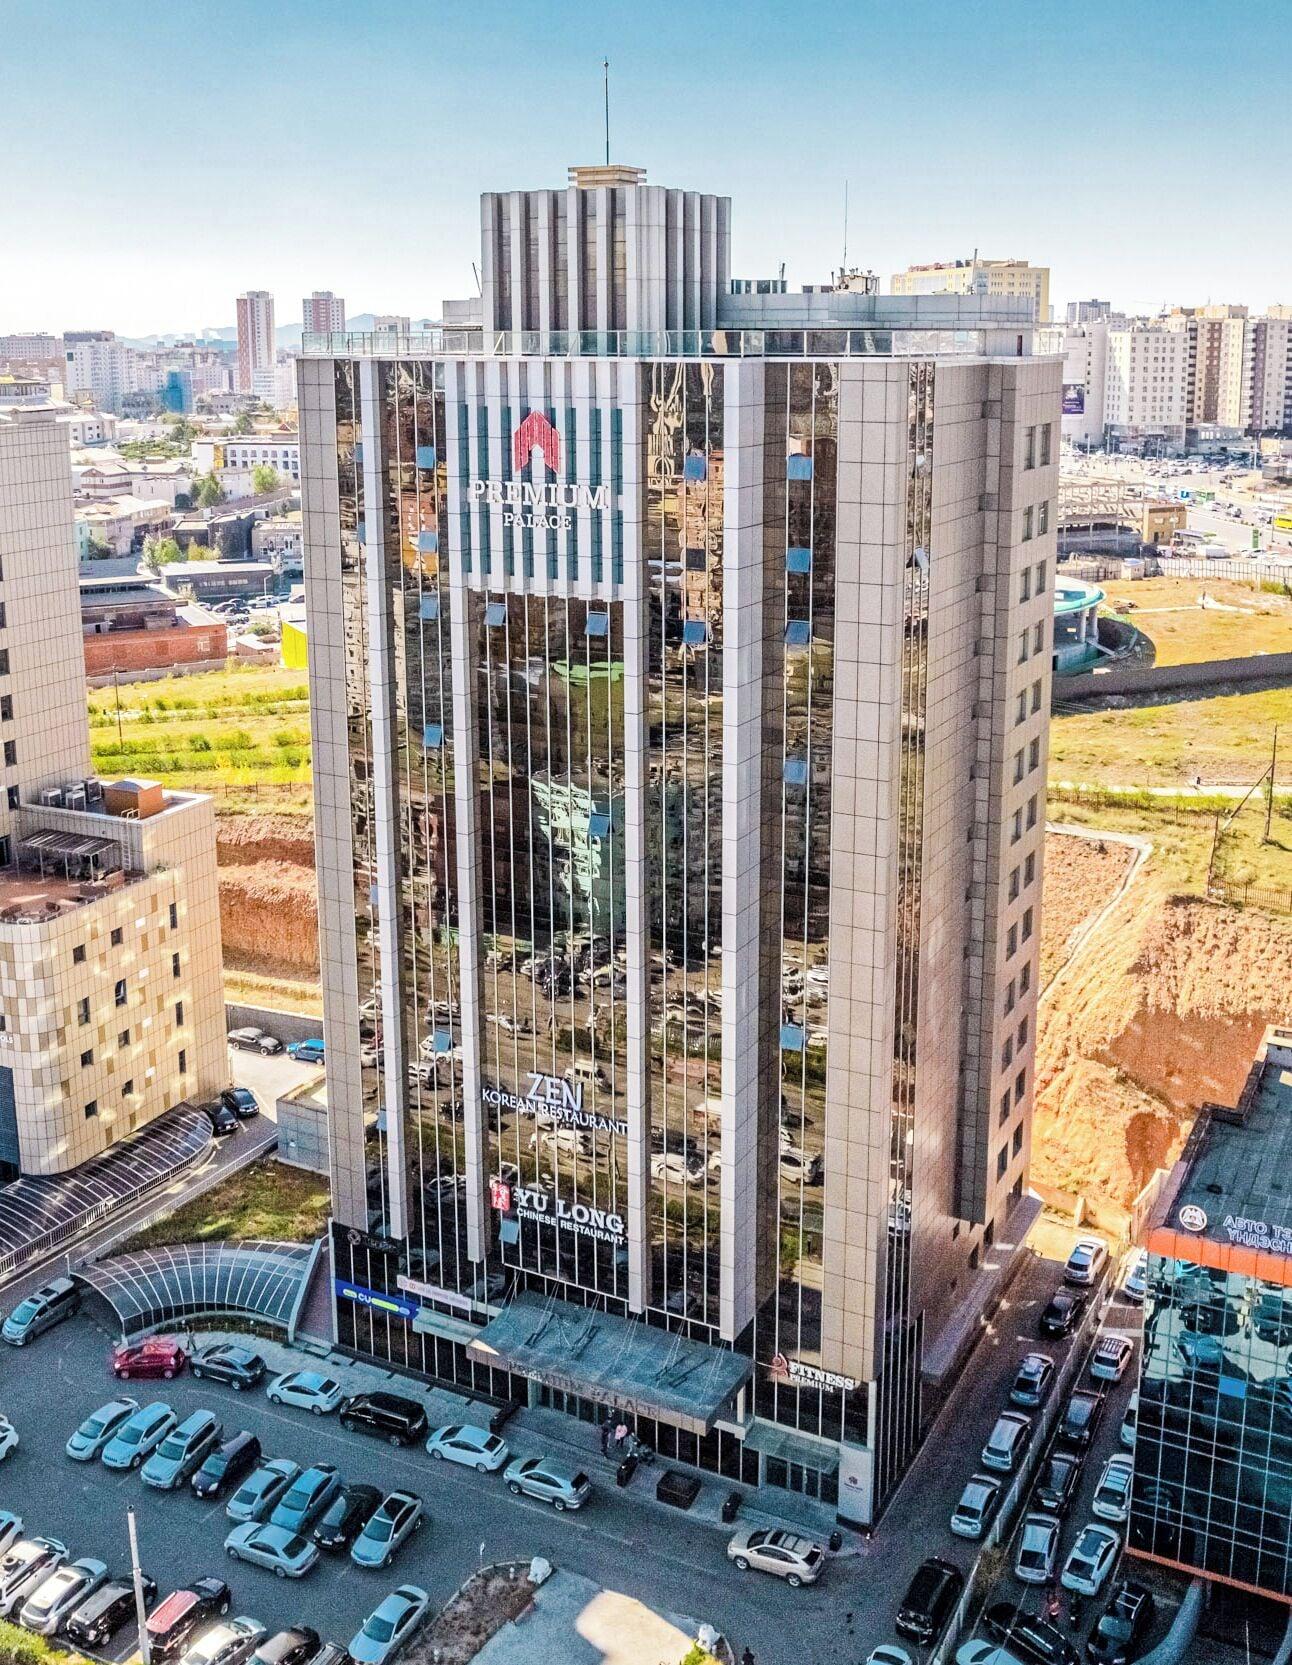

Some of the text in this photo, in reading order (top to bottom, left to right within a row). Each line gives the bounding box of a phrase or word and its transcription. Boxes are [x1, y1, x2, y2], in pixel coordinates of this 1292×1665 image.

[468, 480, 609, 510] PREMIUM
[503, 512, 572, 530] PALACE
[526, 1072, 584, 1111] ZEN
[482, 1088, 628, 1136] KOREAN RESTAURANT
[515, 1187, 549, 1212] YU
[556, 1199, 624, 1235] LONG
[1223, 1215, 1267, 1235] АВТО
[516, 1208, 625, 1246] CHINESE RESTAURANT
[358, 1293, 371, 1304] CU
[788, 1361, 855, 1391] FITNESS
[790, 1374, 834, 1393] PREMIUM
